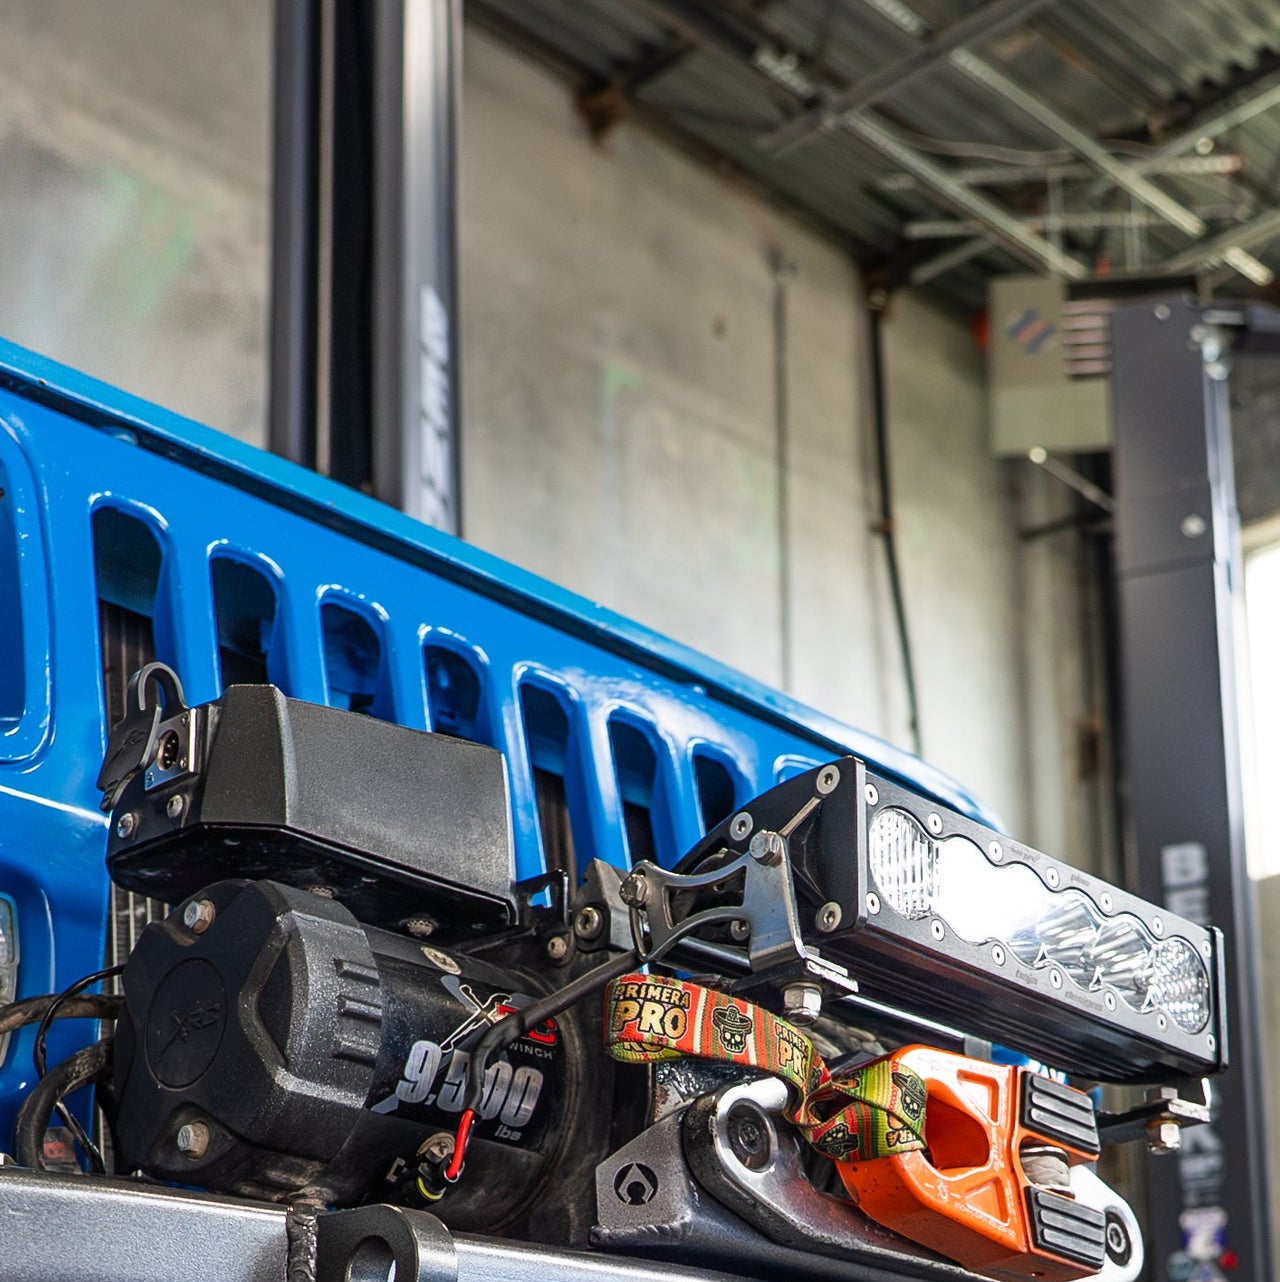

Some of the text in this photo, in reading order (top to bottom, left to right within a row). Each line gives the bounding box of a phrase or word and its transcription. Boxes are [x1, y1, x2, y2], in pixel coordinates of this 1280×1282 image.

[615, 983, 692, 1009] PRIMERA
[440, 984, 557, 1053] XC
[613, 998, 688, 1040] PRO
[395, 1040, 544, 1127] 9,500
[494, 1125, 522, 1141] lbs
